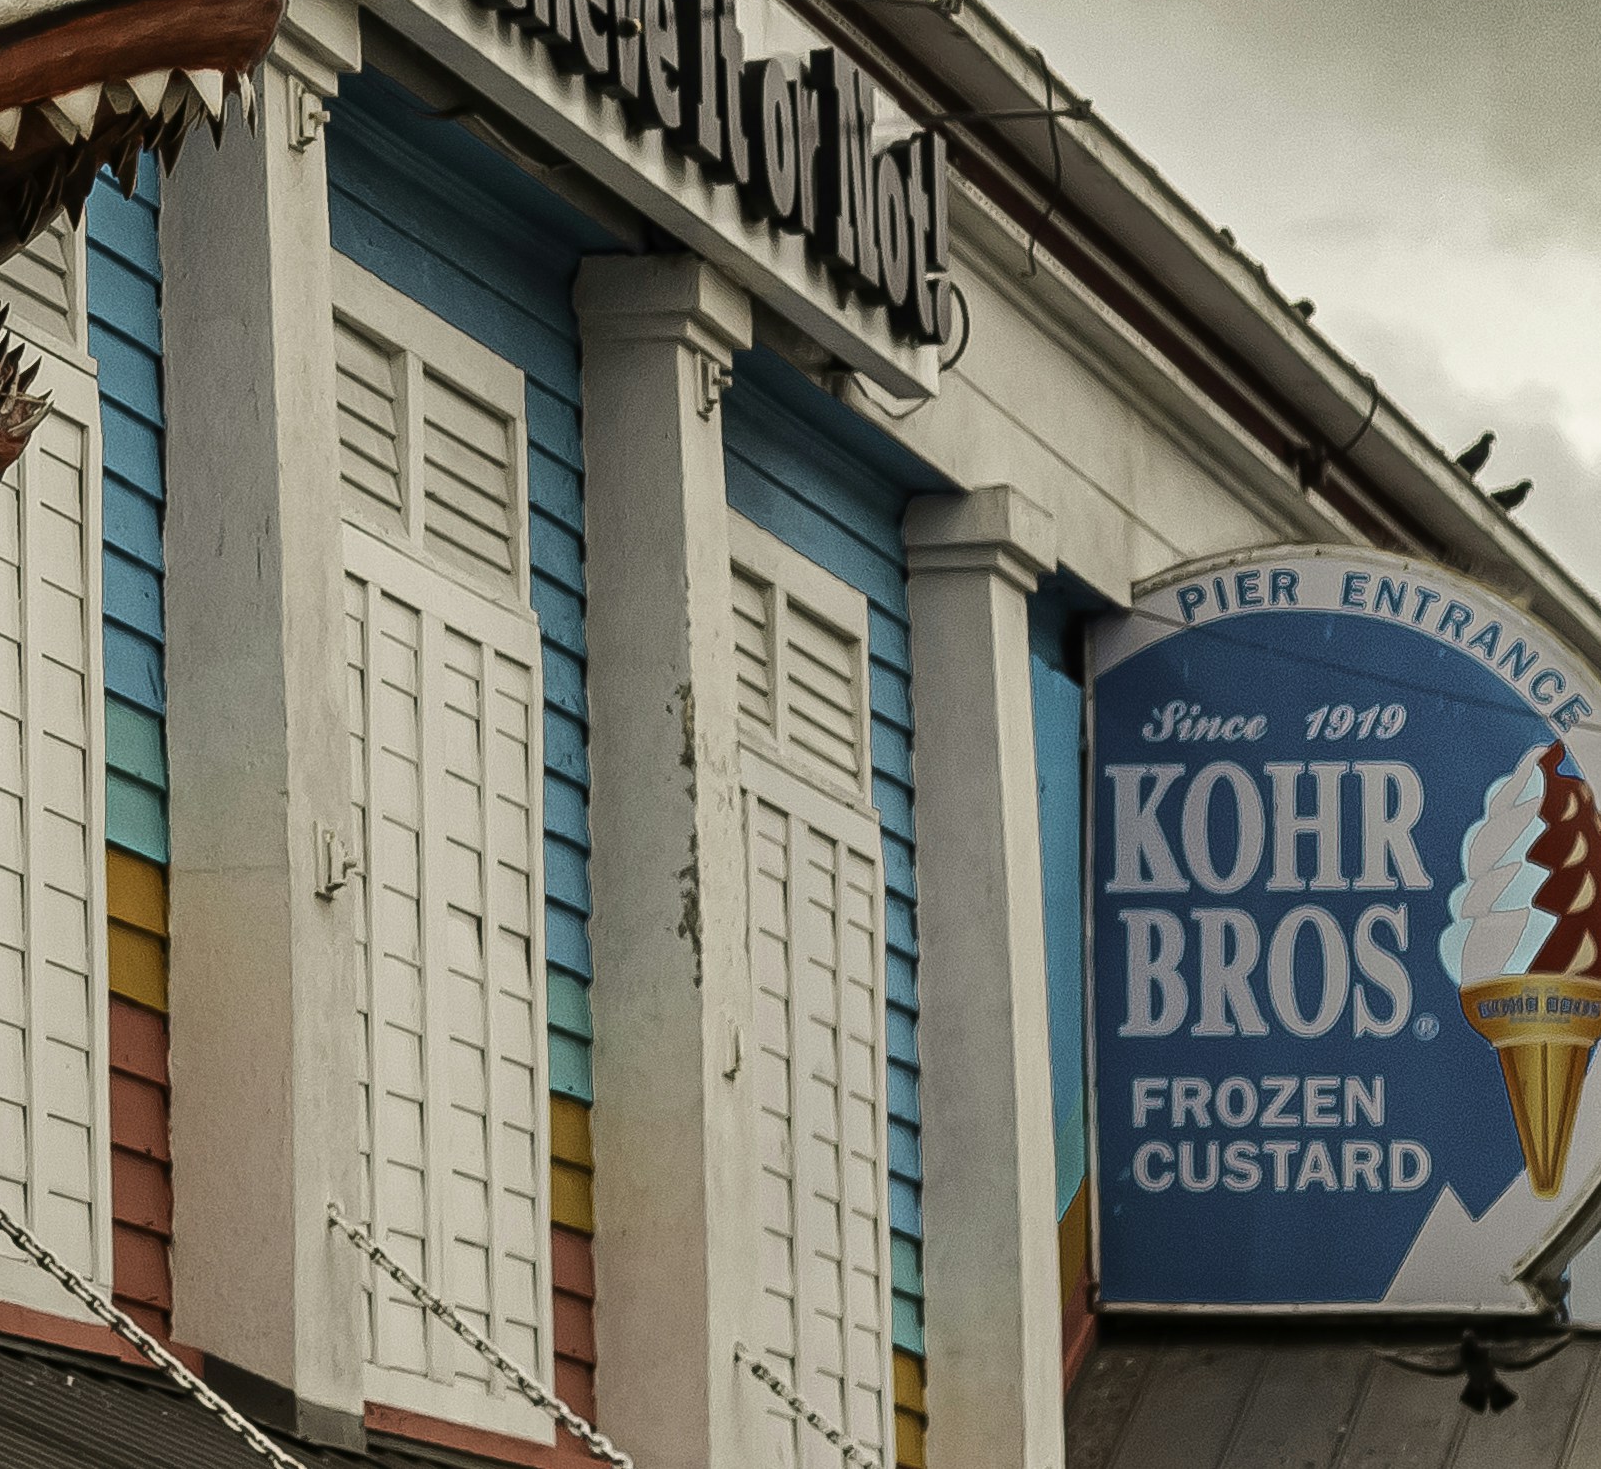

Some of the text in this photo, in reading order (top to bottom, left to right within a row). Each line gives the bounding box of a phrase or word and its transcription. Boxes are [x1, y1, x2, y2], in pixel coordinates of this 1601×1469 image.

[743, 56, 820, 234] or
[811, 46, 952, 345] Not!
[1177, 567, 1593, 733] PIER ENTRANCE
[1141, 700, 1408, 744] Since 1919
[1104, 759, 1434, 895] KOHR
[1130, 1075, 1386, 1130] FROZEN
[1130, 1139, 1433, 1194] CUSTARD
